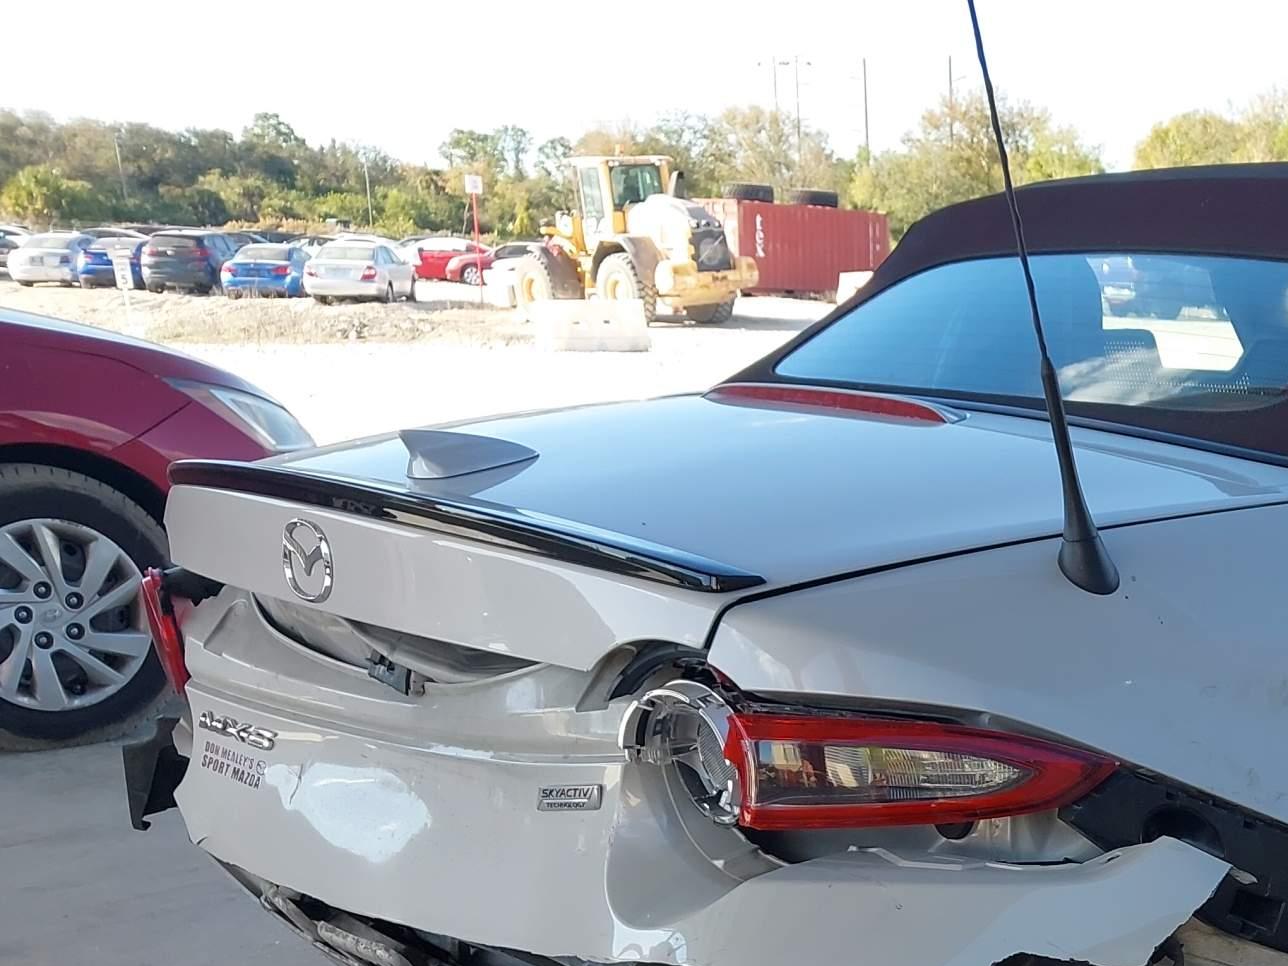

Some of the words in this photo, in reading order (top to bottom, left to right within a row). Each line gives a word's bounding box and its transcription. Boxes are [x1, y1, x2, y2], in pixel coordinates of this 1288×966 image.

[205, 741, 220, 755] DON
[202, 754, 230, 776] SPORT
[230, 767, 262, 790] MAZDA
[541, 787, 590, 798] SKYACTIV
